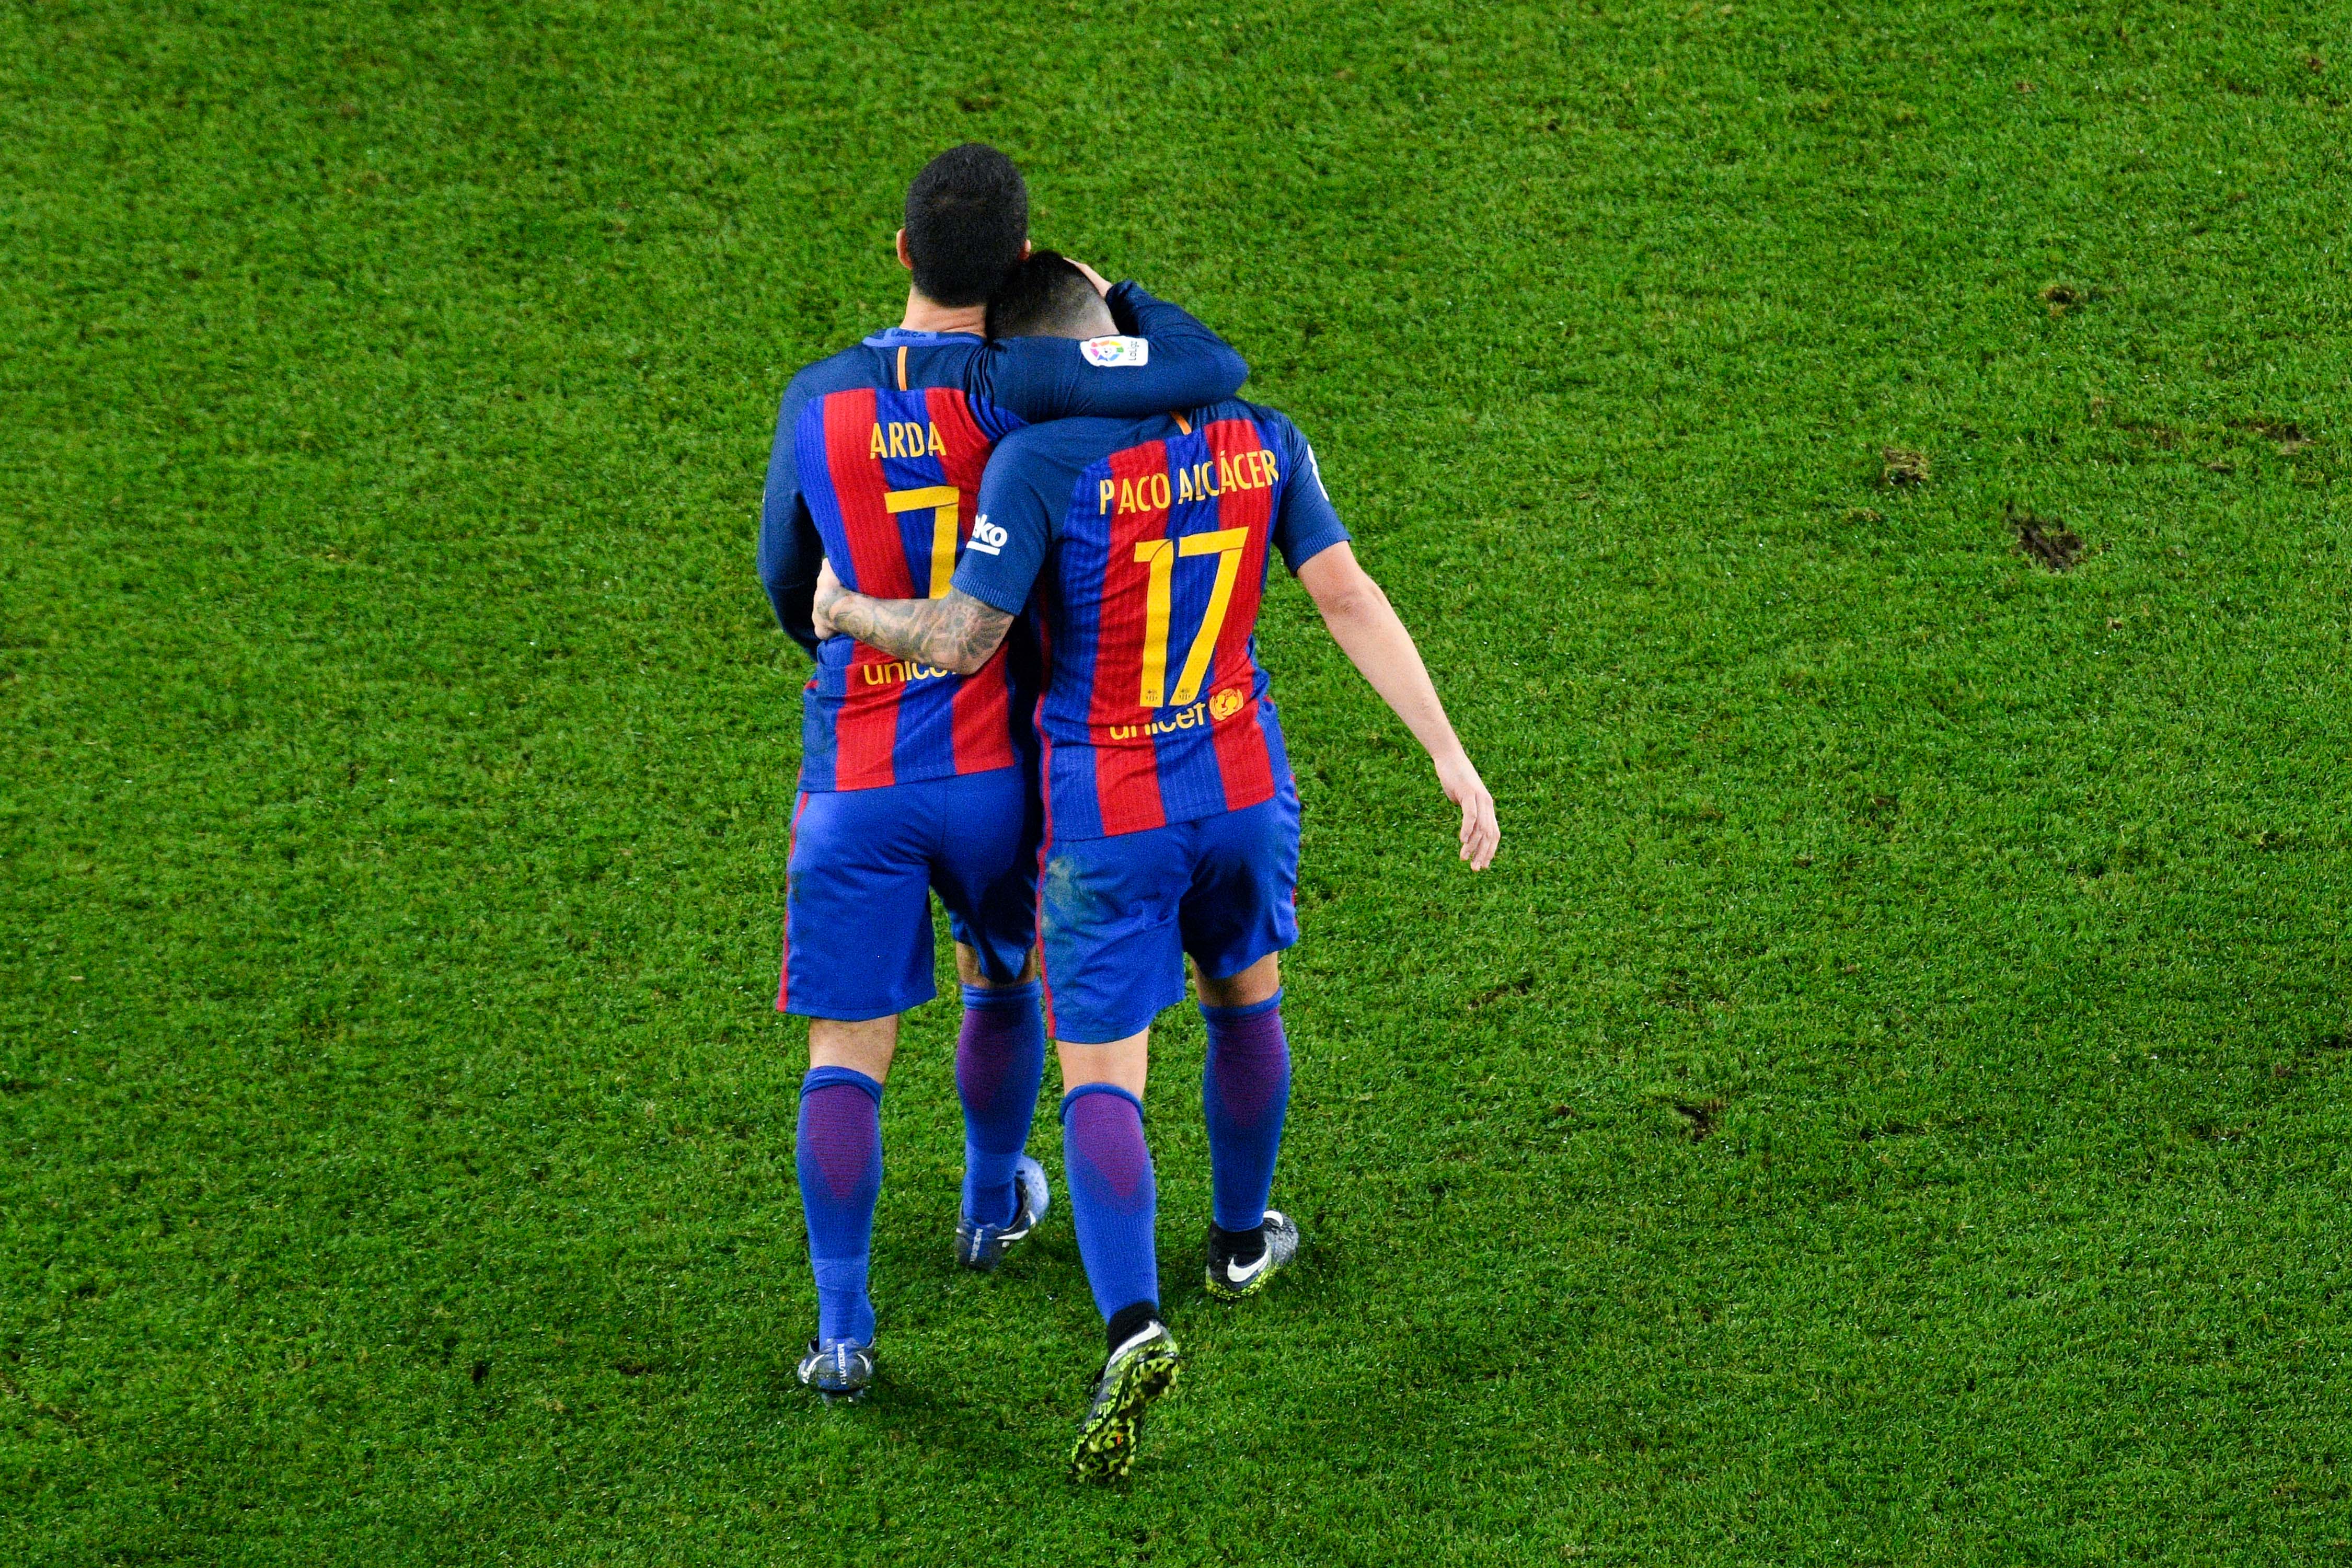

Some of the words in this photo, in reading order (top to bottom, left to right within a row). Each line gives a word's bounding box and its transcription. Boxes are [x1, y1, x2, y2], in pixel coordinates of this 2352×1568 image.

[870, 422, 947, 459] ARDA
[1099, 473, 1171, 515] PACO
[1178, 449, 1279, 505] ALCÁCER
[884, 485, 960, 599] 7
[1134, 526, 1249, 707] 17
[863, 661, 956, 685] unic
